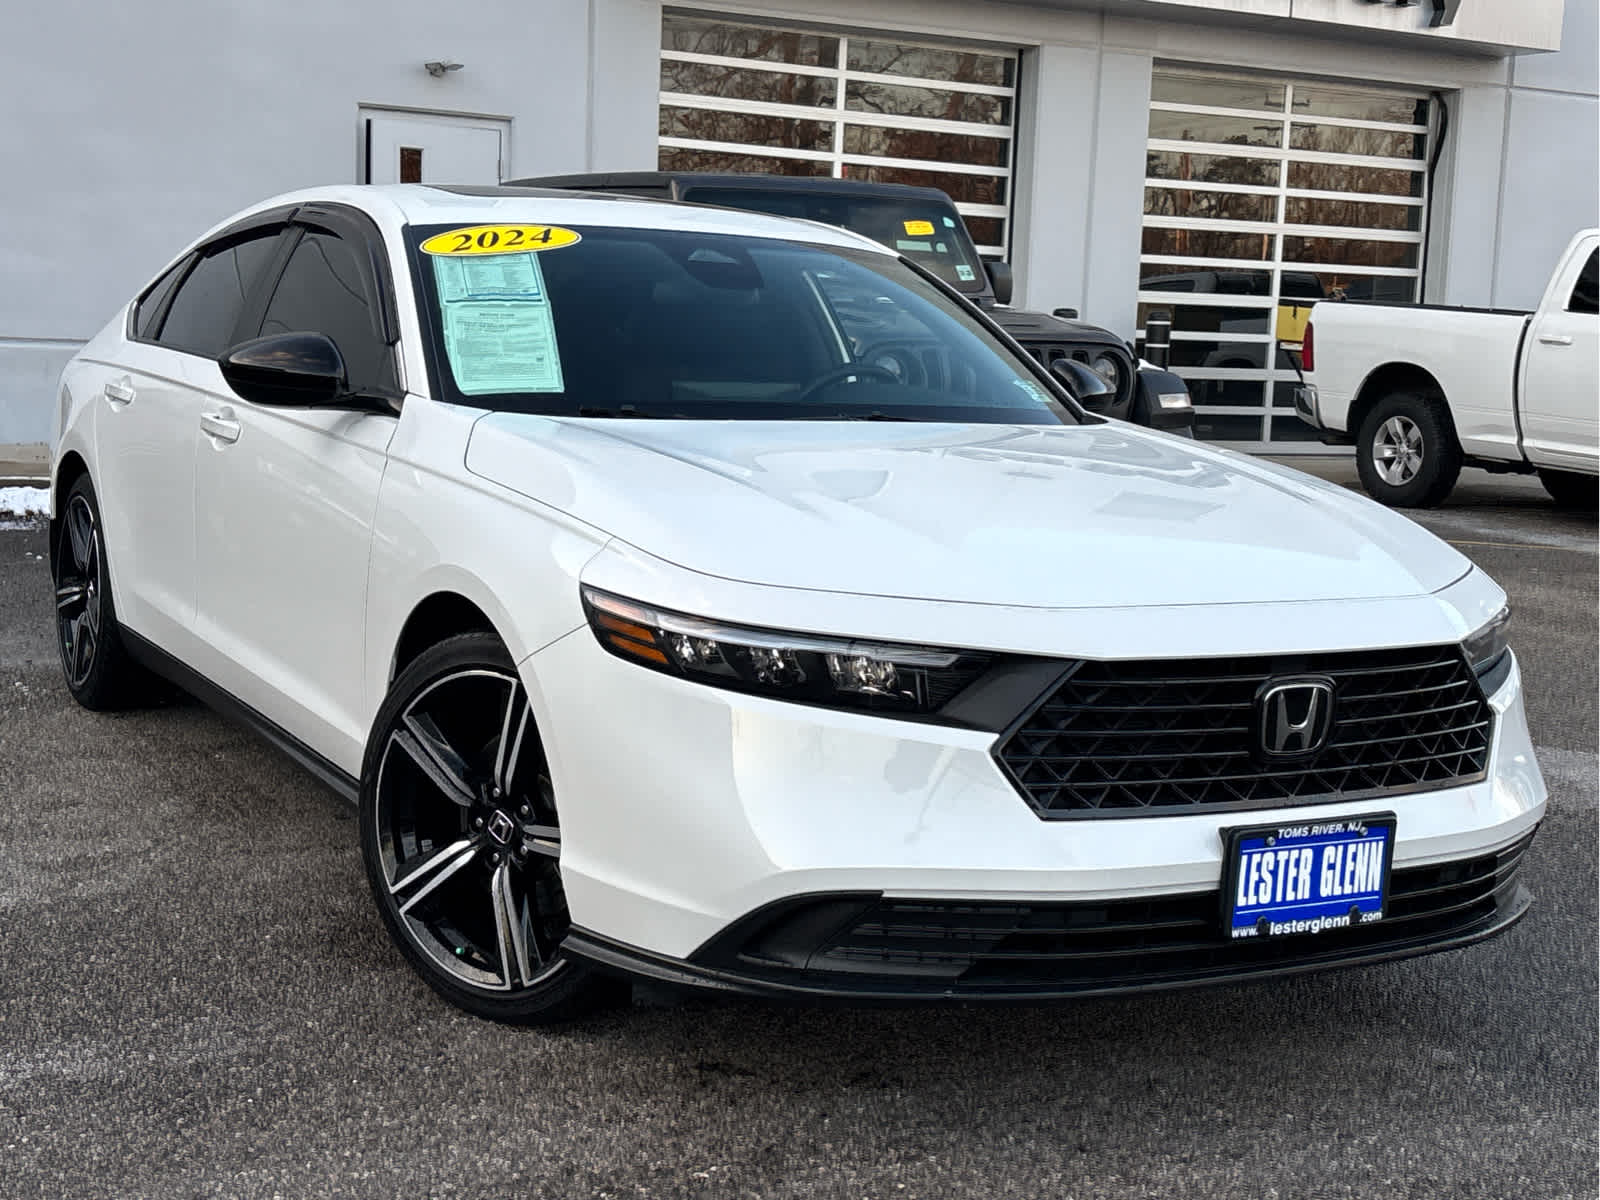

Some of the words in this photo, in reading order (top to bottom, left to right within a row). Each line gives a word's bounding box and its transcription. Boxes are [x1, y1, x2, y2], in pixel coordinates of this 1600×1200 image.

[451, 228, 552, 252] 2024
[1278, 825, 1309, 839] TOMS
[1237, 848, 1314, 907] LESTER
[1320, 840, 1384, 898] GLENN
